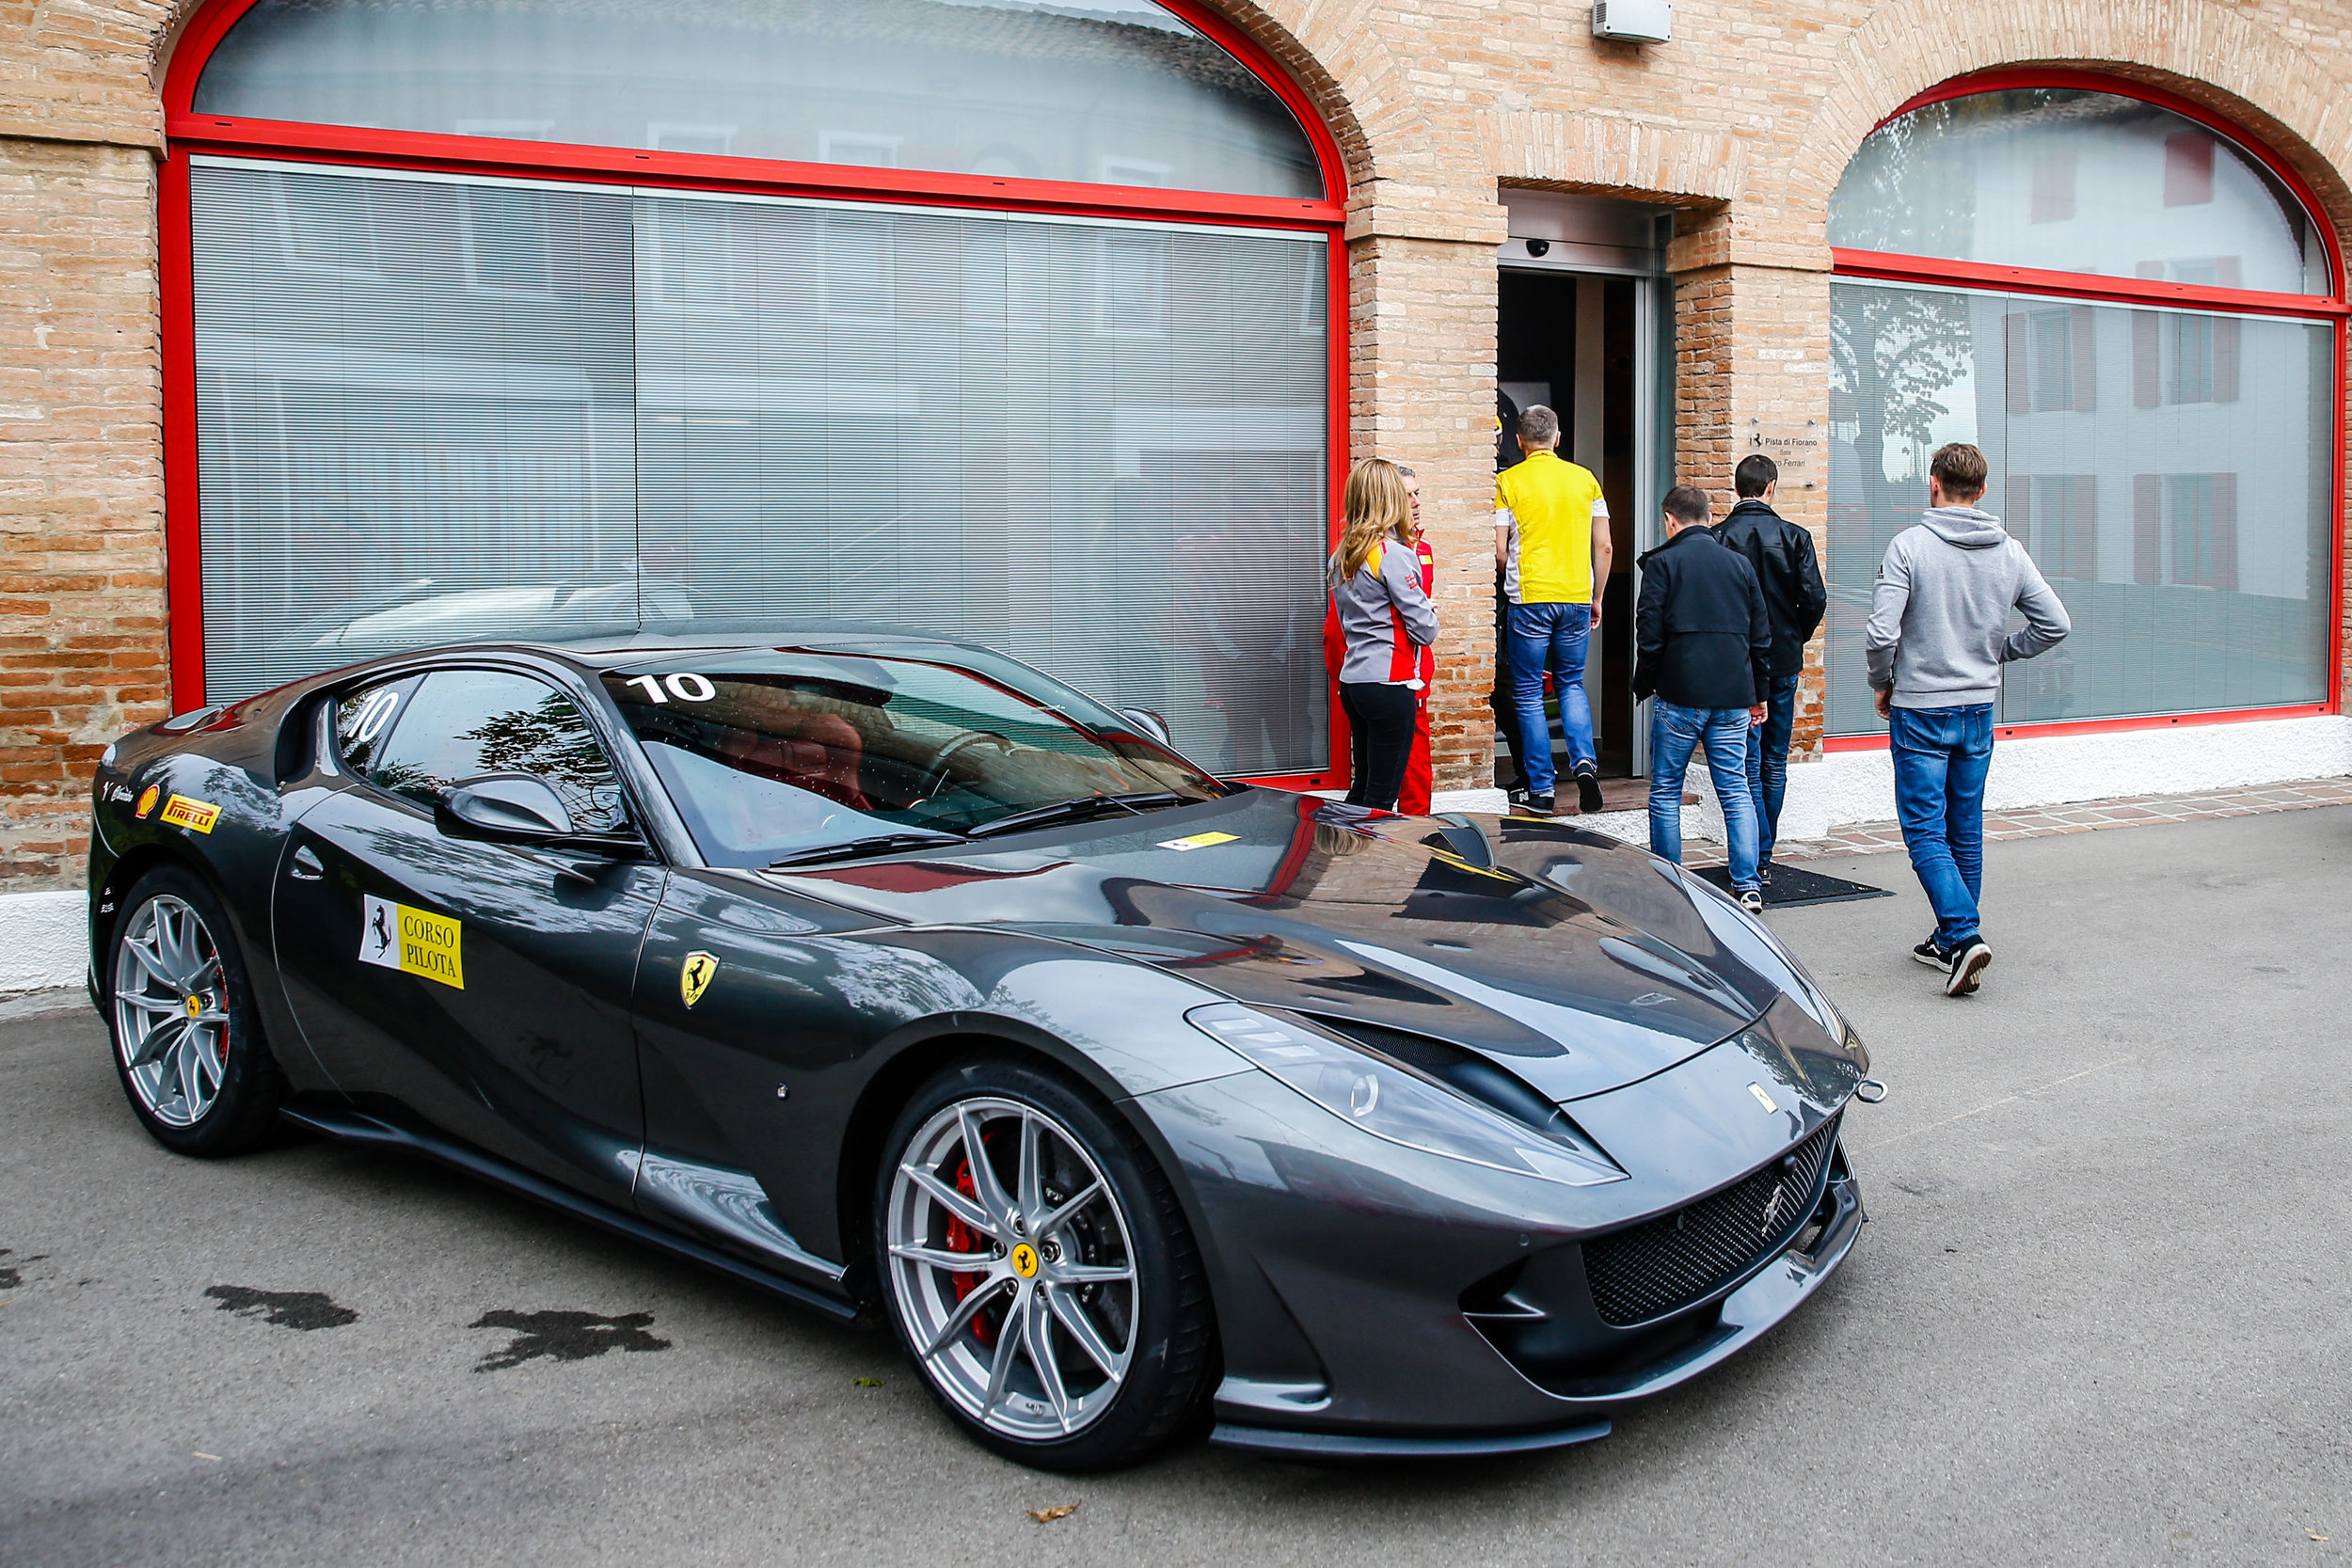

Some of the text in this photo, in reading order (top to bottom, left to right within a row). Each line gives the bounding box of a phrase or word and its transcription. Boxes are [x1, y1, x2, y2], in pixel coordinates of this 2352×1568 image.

[1765, 437, 1818, 446] Pista di Fiorano
[1783, 458, 1806, 467] Ferrari
[625, 672, 717, 704] 10
[346, 689, 400, 743] 10
[167, 800, 215, 827] PIRELLI
[404, 915, 454, 949] CORSO
[405, 942, 457, 978] PILOTA
